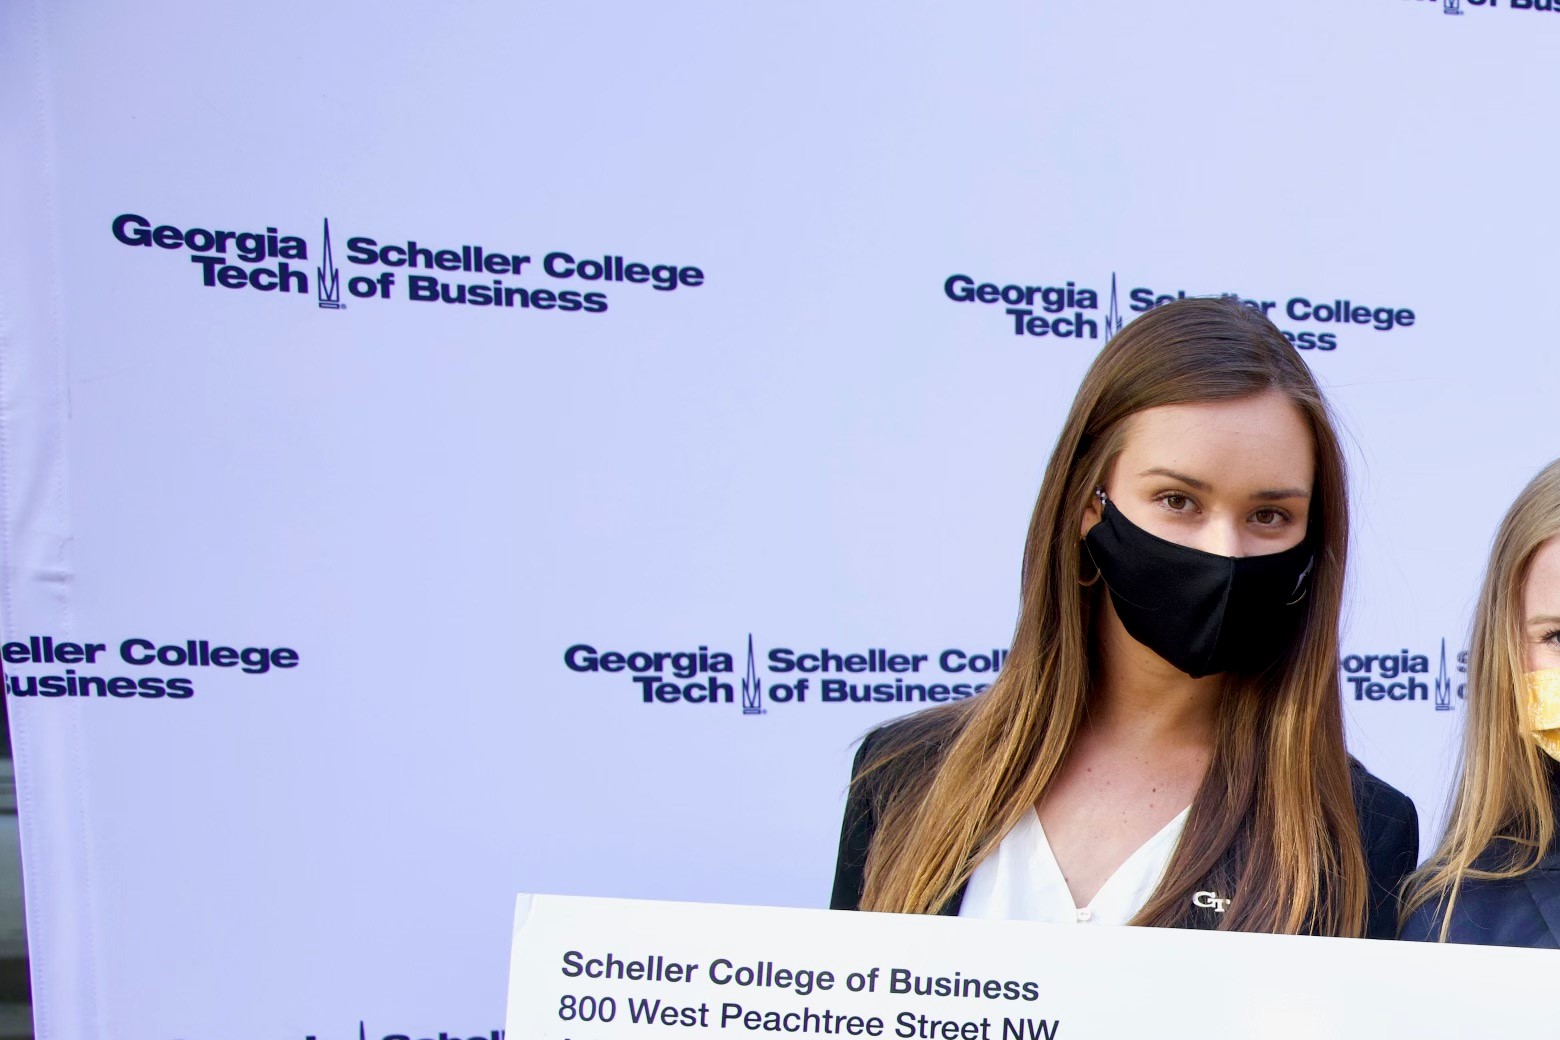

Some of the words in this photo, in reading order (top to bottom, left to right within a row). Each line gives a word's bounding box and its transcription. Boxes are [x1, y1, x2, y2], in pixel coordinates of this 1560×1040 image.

[111, 213, 308, 262] Georgia
[191, 255, 309, 294] Tech
[346, 236, 531, 276] Scheller
[543, 251, 705, 292] College
[347, 275, 395, 299] of
[408, 276, 609, 313] Business
[943, 274, 1098, 312] Georgia
[1005, 307, 1098, 340] Tech
[1285, 297, 1416, 331] College
[1, 636, 106, 664] eller
[119, 638, 300, 674] College
[564, 644, 734, 677] Georgia
[767, 648, 929, 673] Scheller
[1341, 648, 1430, 679] orgia
[3, 669, 195, 699] usiness
[632, 676, 734, 704] Tech
[768, 678, 810, 702] of
[1347, 676, 1430, 701] Tech
[561, 951, 698, 985] Scheller
[708, 958, 835, 998] College
[847, 970, 879, 994] of
[889, 969, 1040, 1003] Business
[557, 995, 617, 1025] 800
[627, 998, 710, 1031] West
[720, 1002, 884, 1038] Peachtree
